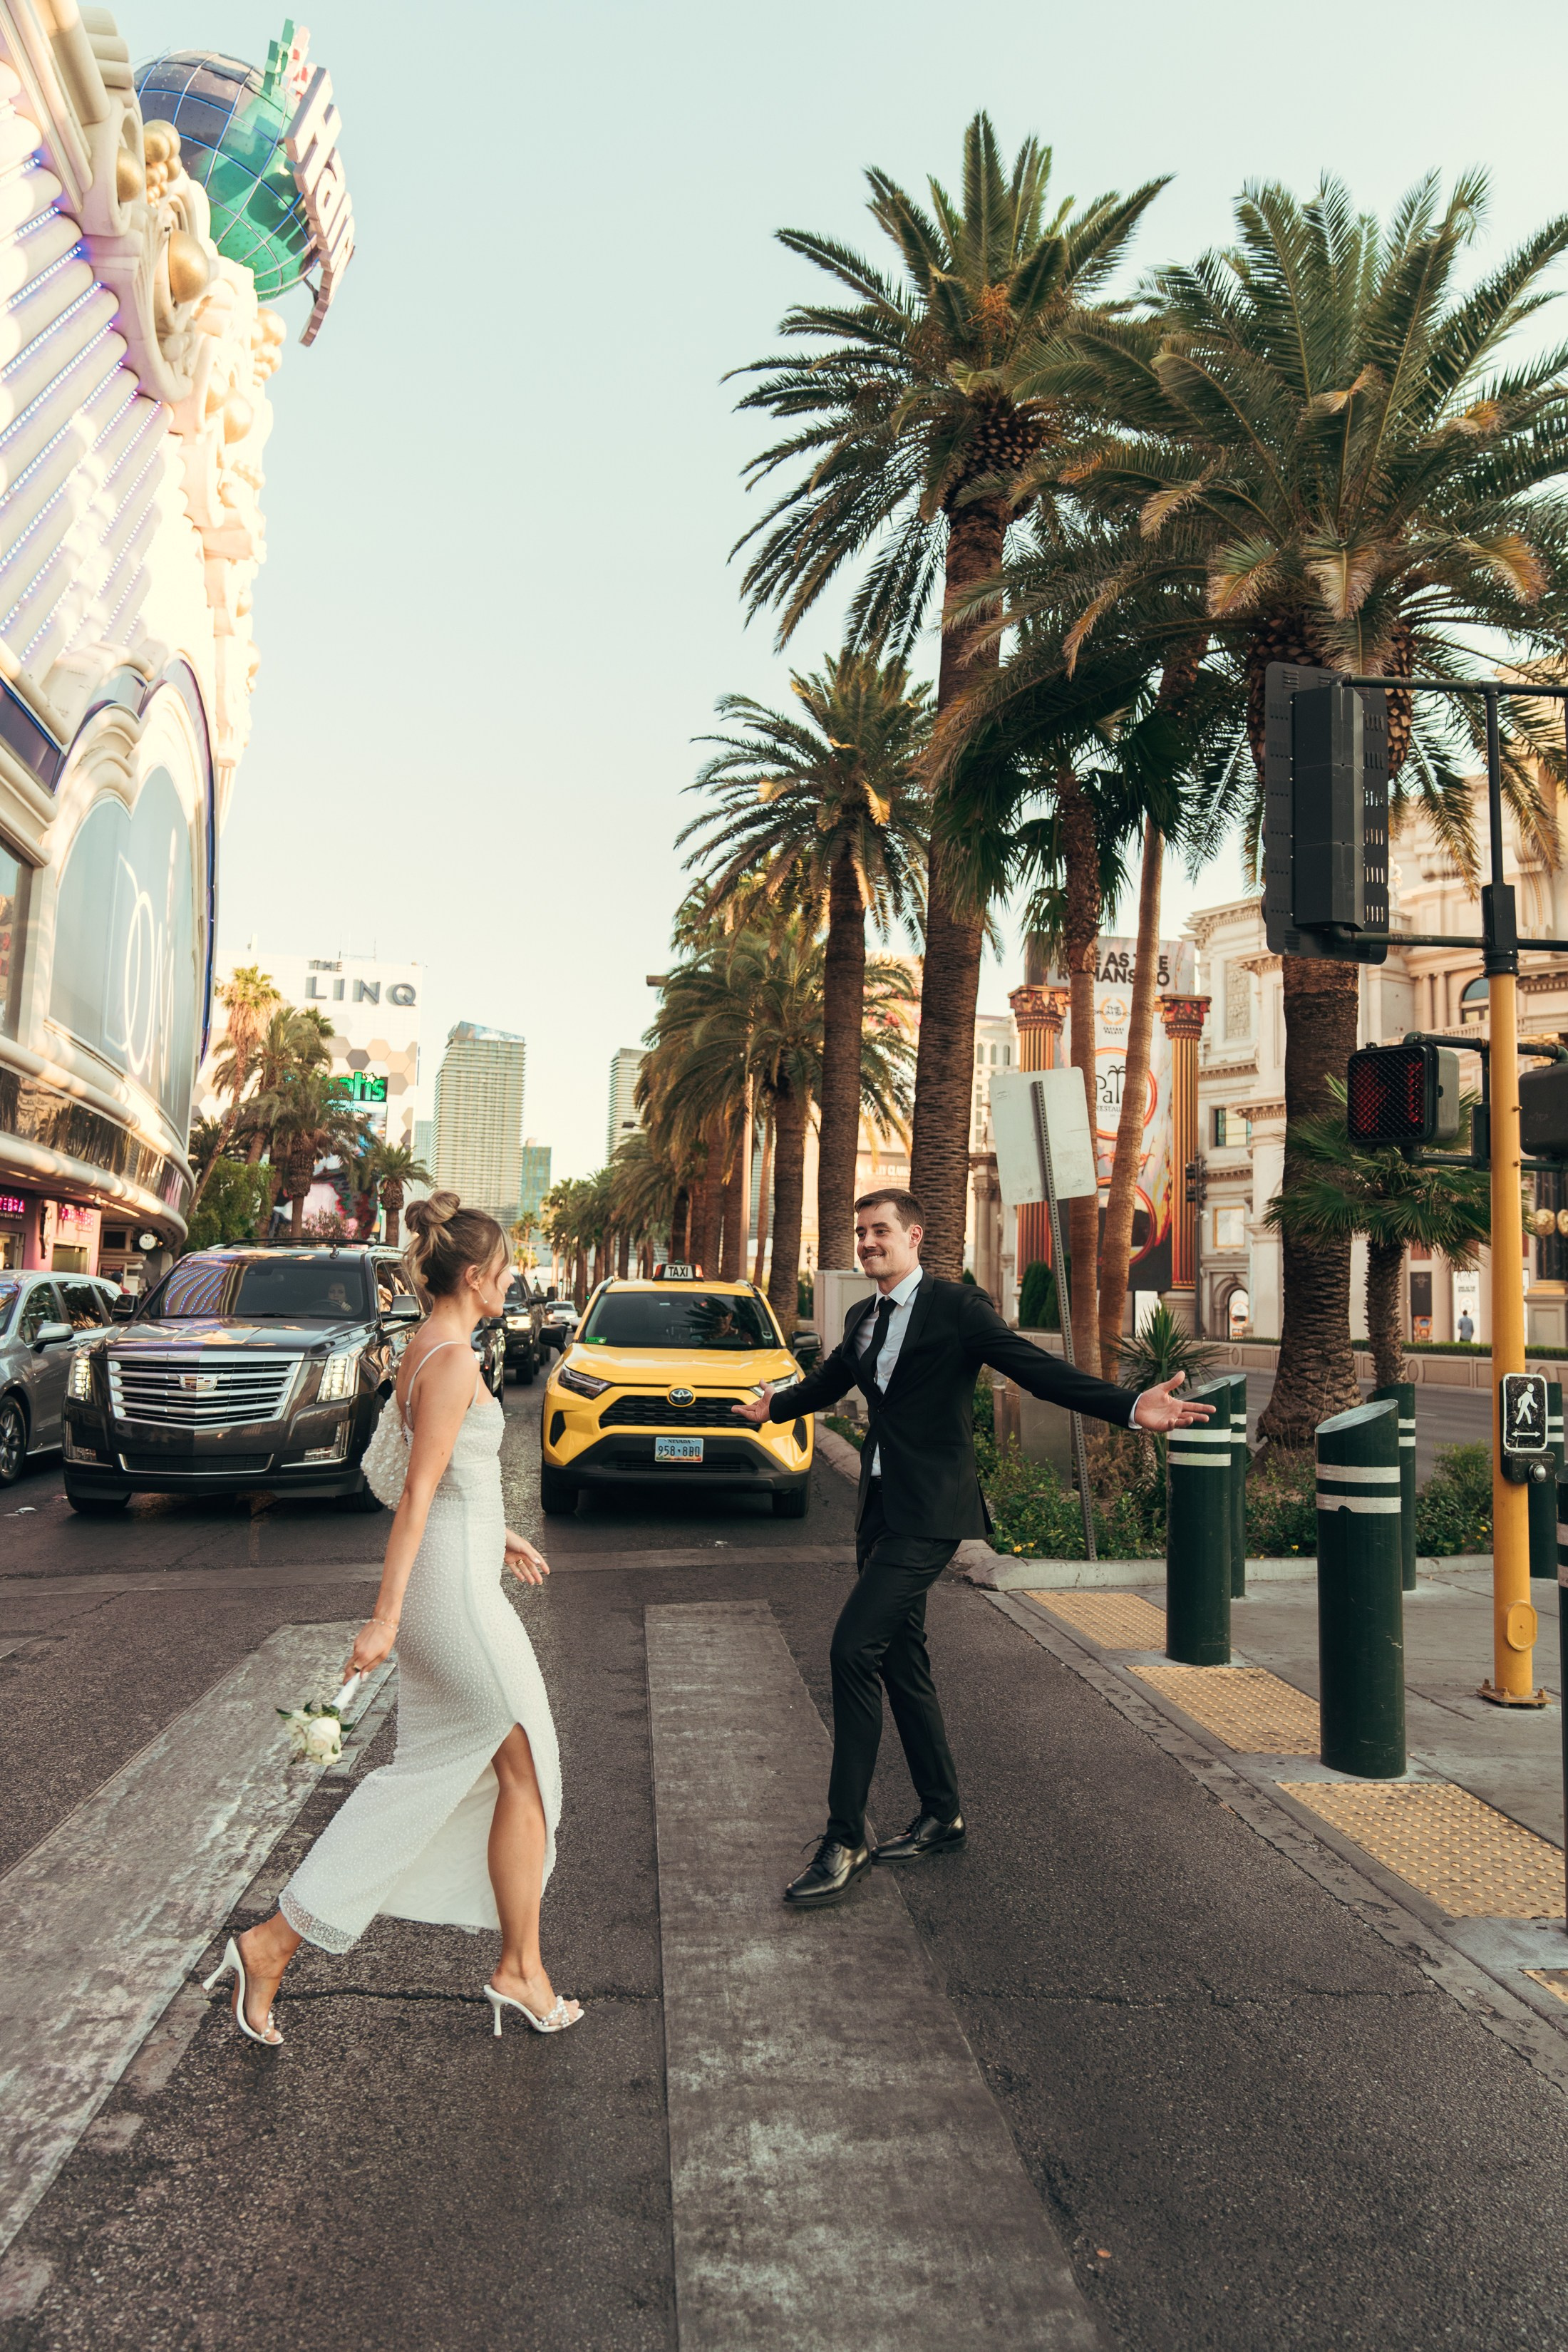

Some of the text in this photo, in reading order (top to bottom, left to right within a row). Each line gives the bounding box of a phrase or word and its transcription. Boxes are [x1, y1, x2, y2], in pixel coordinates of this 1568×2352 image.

[314, 959, 343, 971] THE
[1106, 952, 1130, 968] AS
[311, 976, 416, 1006] LINQ
[668, 1266, 688, 1278] TAXI
